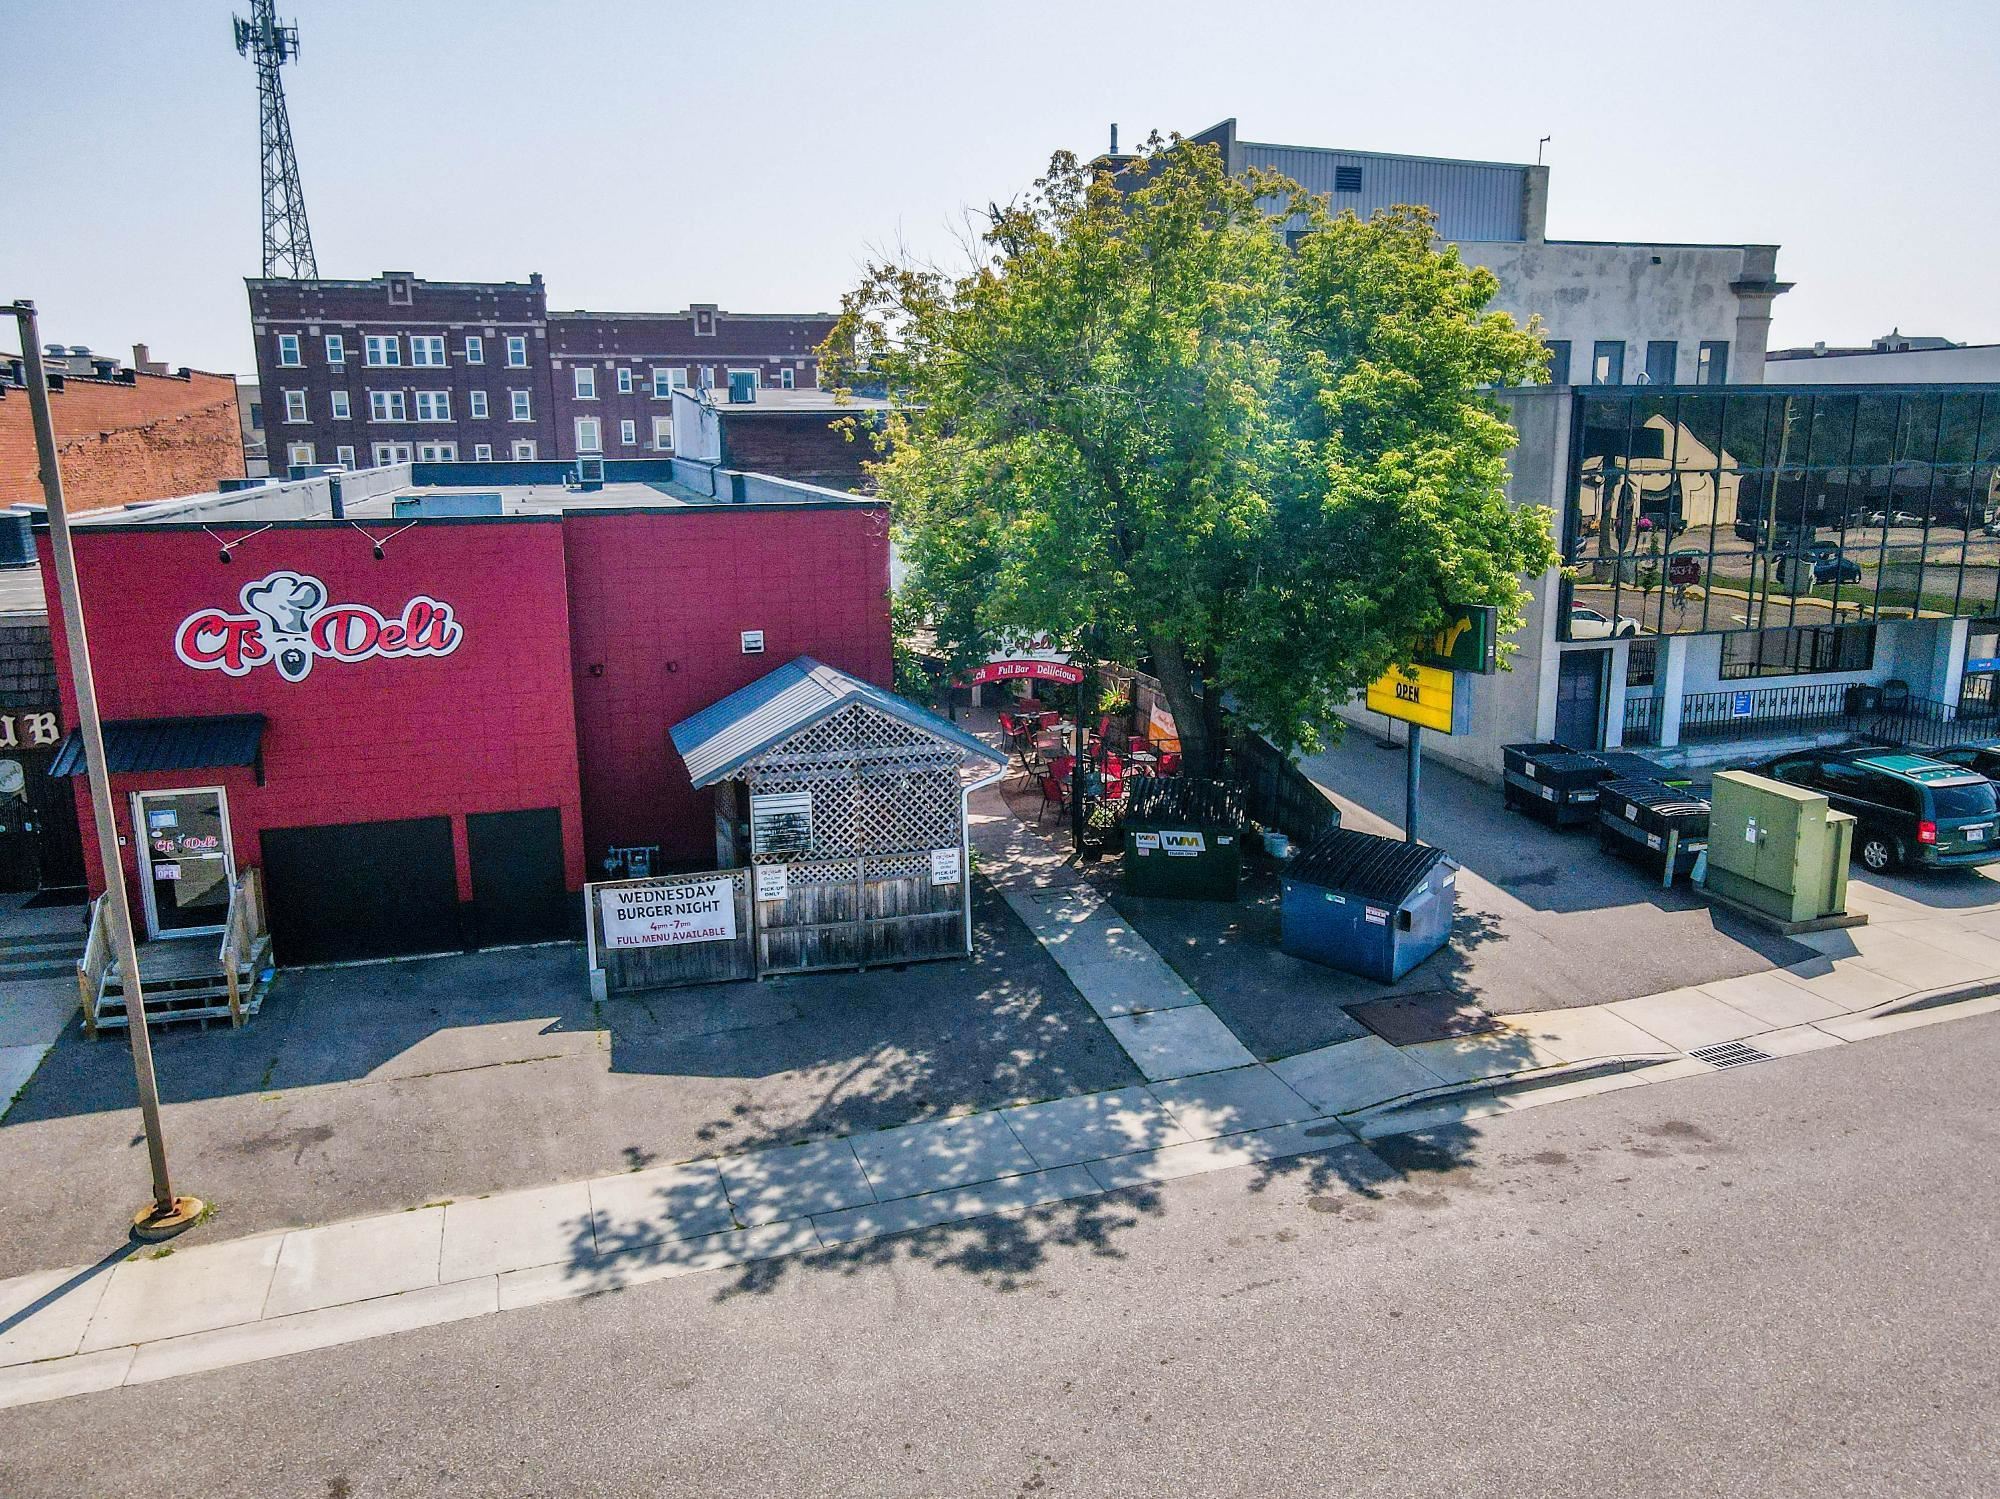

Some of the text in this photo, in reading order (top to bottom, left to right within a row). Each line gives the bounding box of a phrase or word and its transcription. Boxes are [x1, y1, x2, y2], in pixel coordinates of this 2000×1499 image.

[310, 602, 457, 656] Deli
[998, 665, 1013, 676] Full
[1015, 665, 1030, 674] Bar
[1396, 682, 1420, 704] OPEN
[1166, 836, 1200, 847] WM
[158, 870, 179, 878] OPEN
[618, 885, 716, 904] WEDNESDAY
[617, 900, 720, 921] BURGER NIGHT
[617, 927, 726, 945] FULL MENU AVAILABLE
